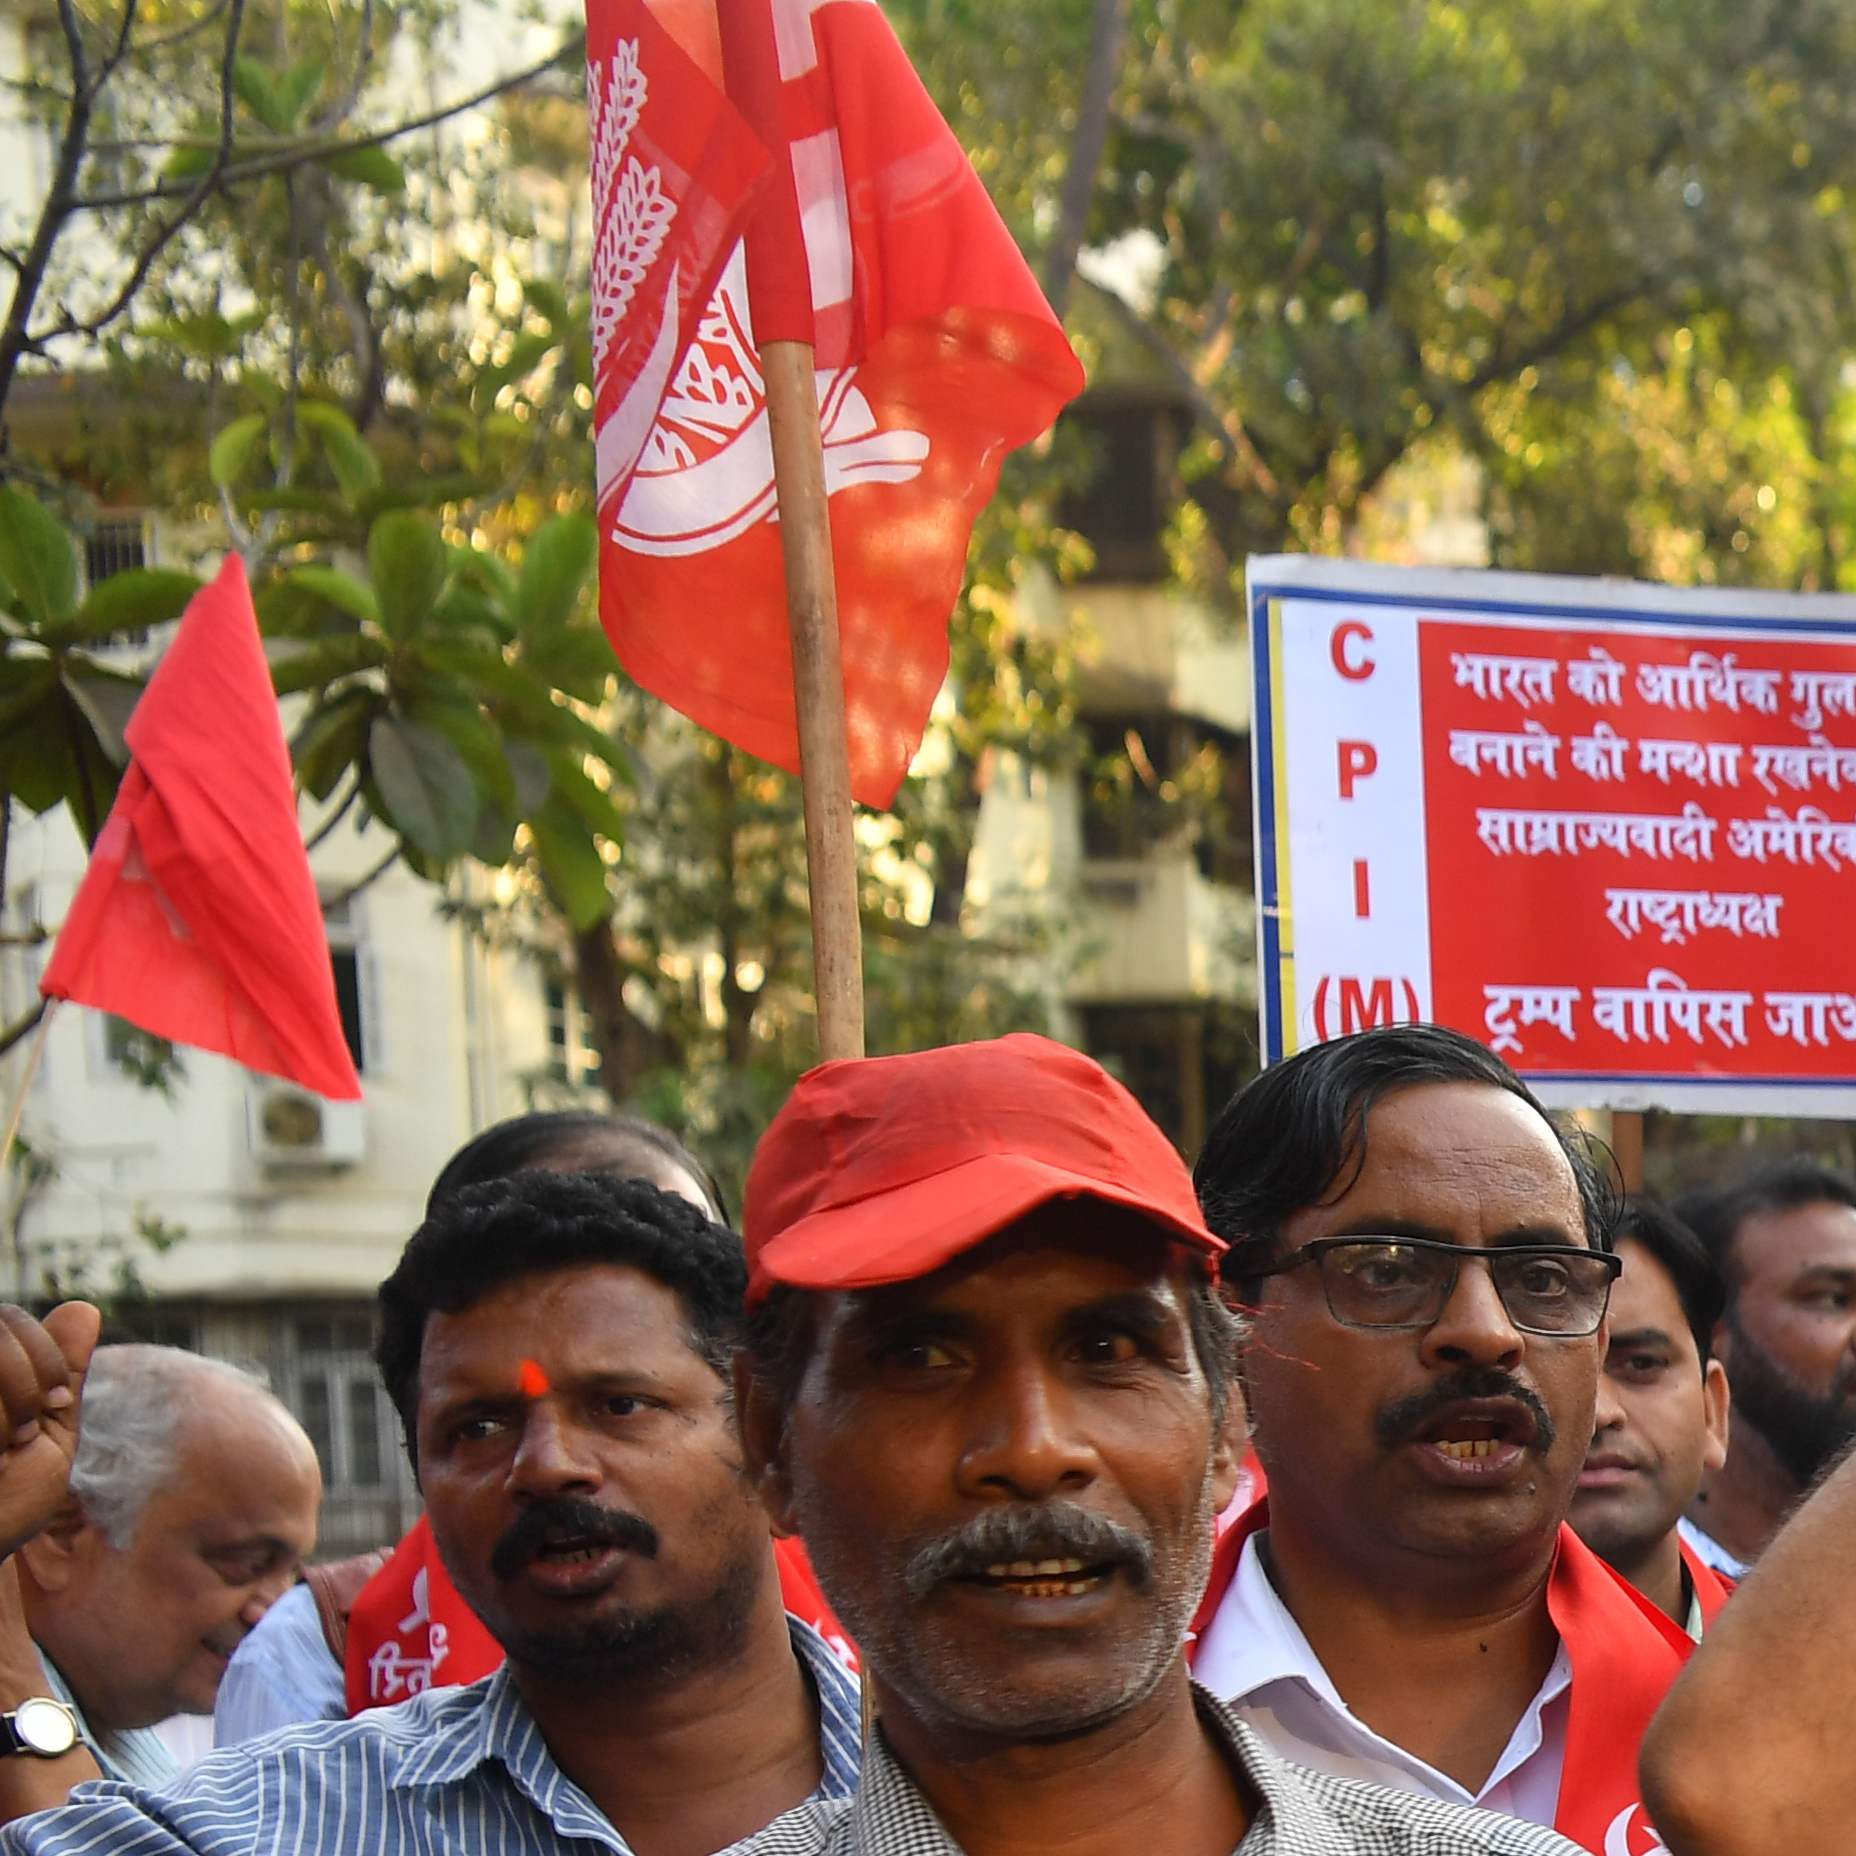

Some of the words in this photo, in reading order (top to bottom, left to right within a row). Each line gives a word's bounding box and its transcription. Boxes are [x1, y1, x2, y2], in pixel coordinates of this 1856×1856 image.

[1331, 621, 1376, 682] C
[1449, 652, 1559, 708] भारत
[1568, 646, 1627, 706] को
[1636, 651, 1782, 714] आर्थिक
[1337, 740, 1378, 799] P
[1449, 720, 1561, 780] बनाने
[1570, 720, 1630, 782] की
[1476, 802, 1718, 863] साम्राज्यवादी
[1354, 859, 1370, 918] I
[1605, 888, 1783, 945] राष्ट्राध्यक्ष
[1483, 985, 1581, 1054] ट्रम्प
[1592, 968, 1754, 1049] वापिस
